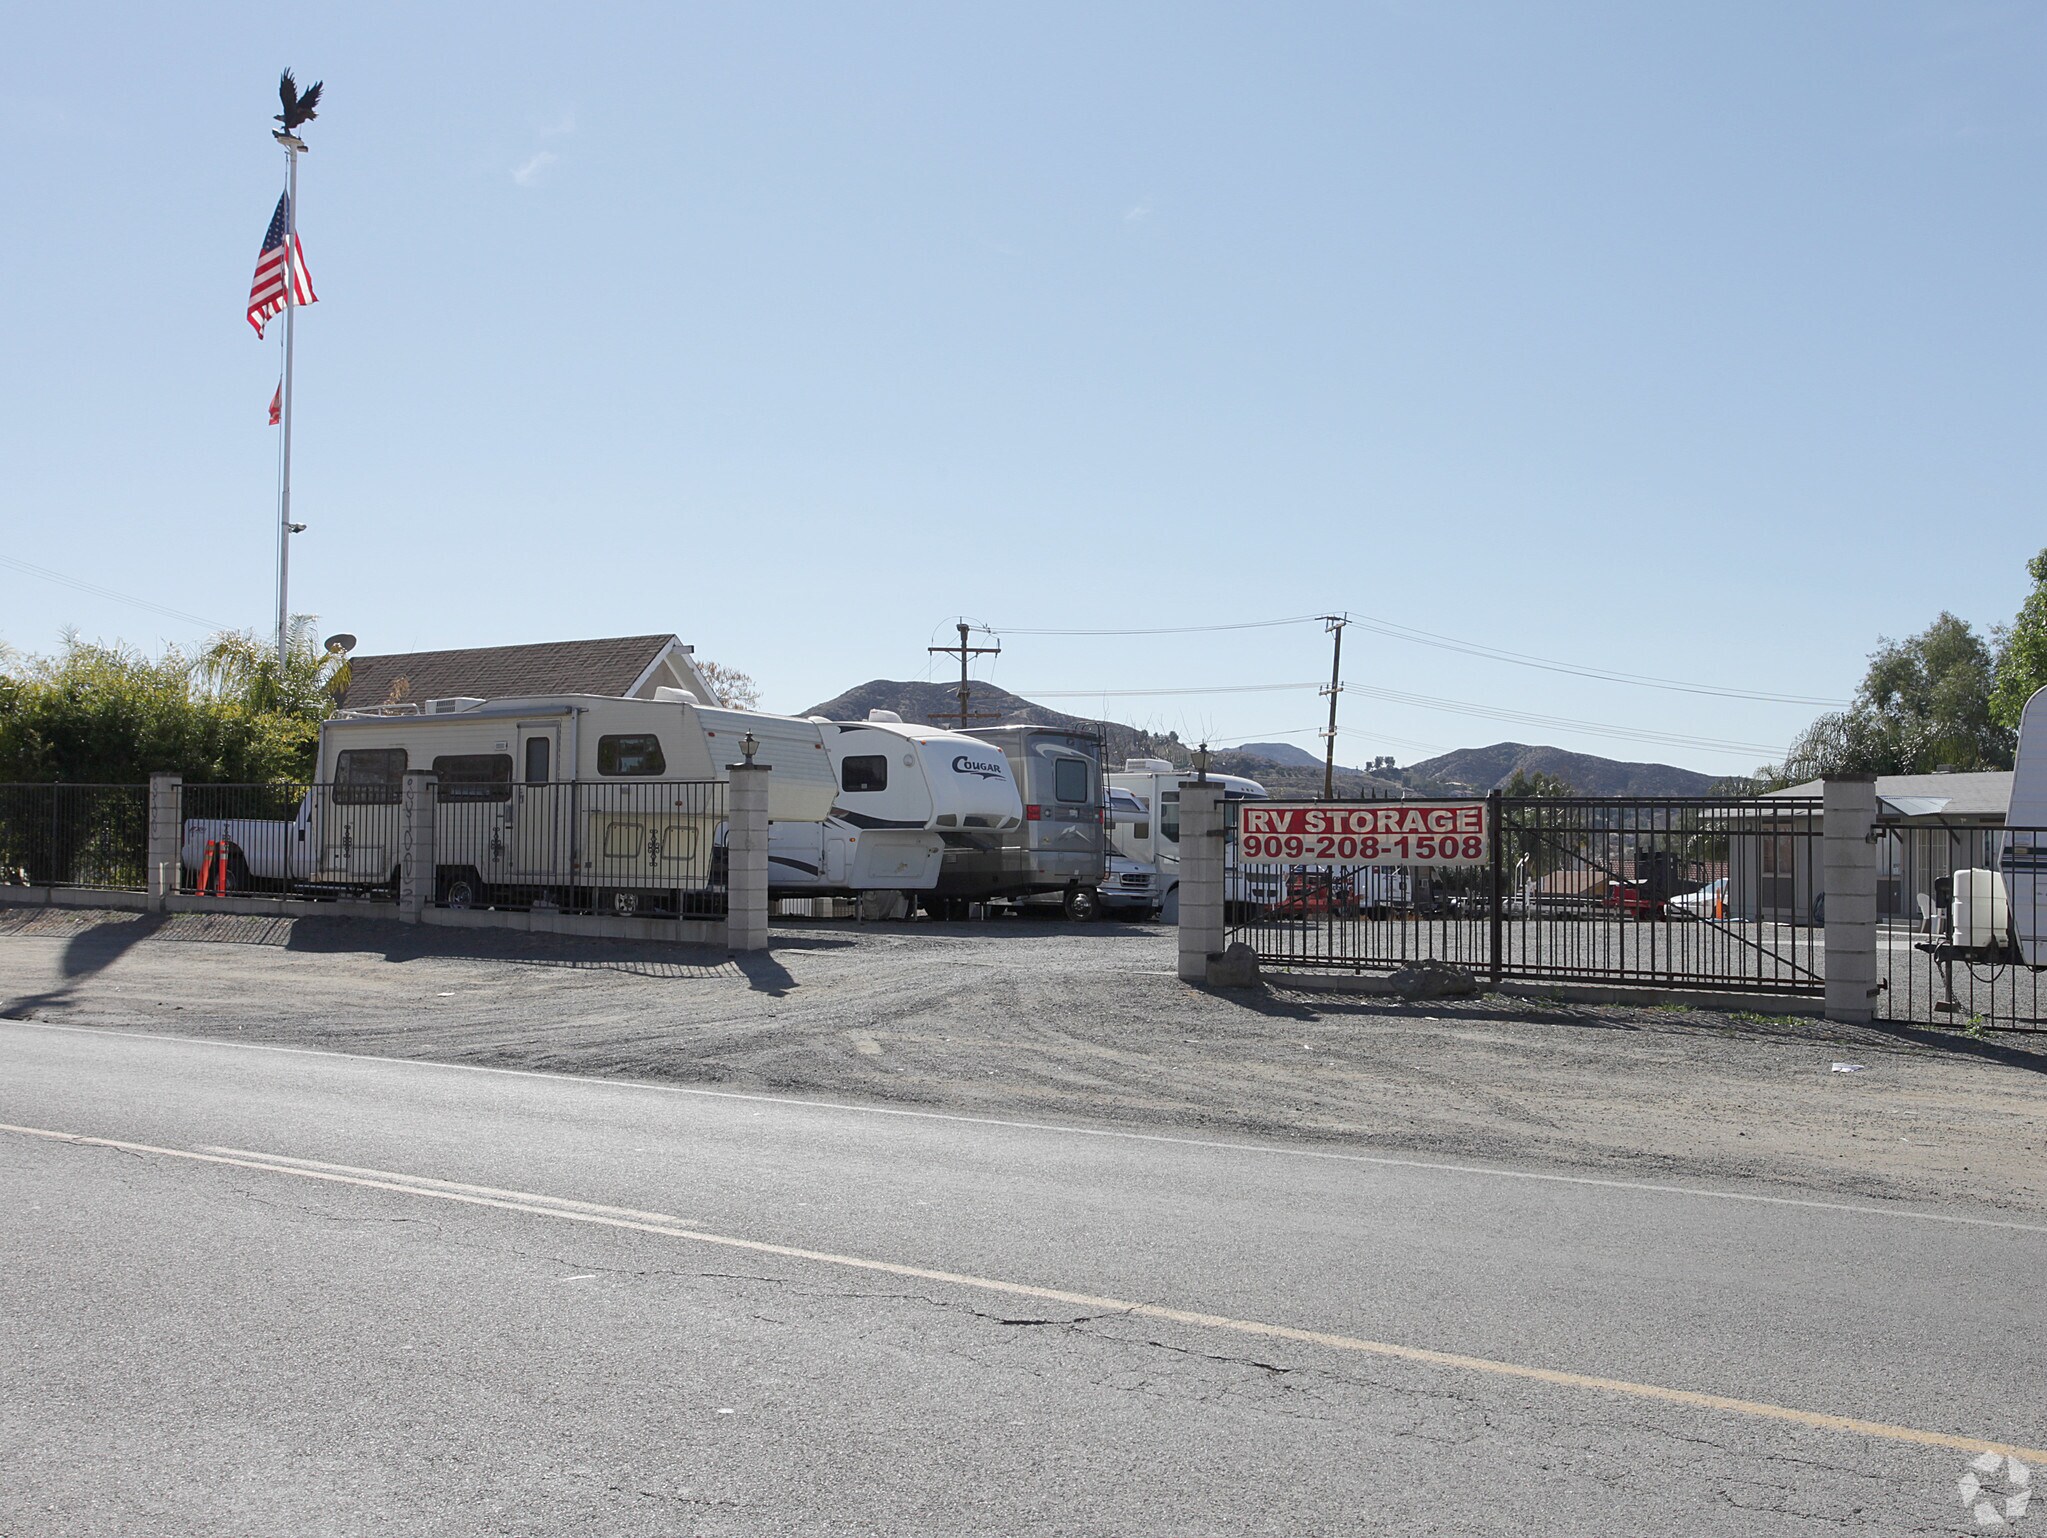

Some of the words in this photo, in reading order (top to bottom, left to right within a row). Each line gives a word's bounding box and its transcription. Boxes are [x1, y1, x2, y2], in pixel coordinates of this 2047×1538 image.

[1248, 810, 1294, 832] RV
[1304, 809, 1479, 833] STORAGE
[1243, 835, 1482, 859] 909-208-1508
